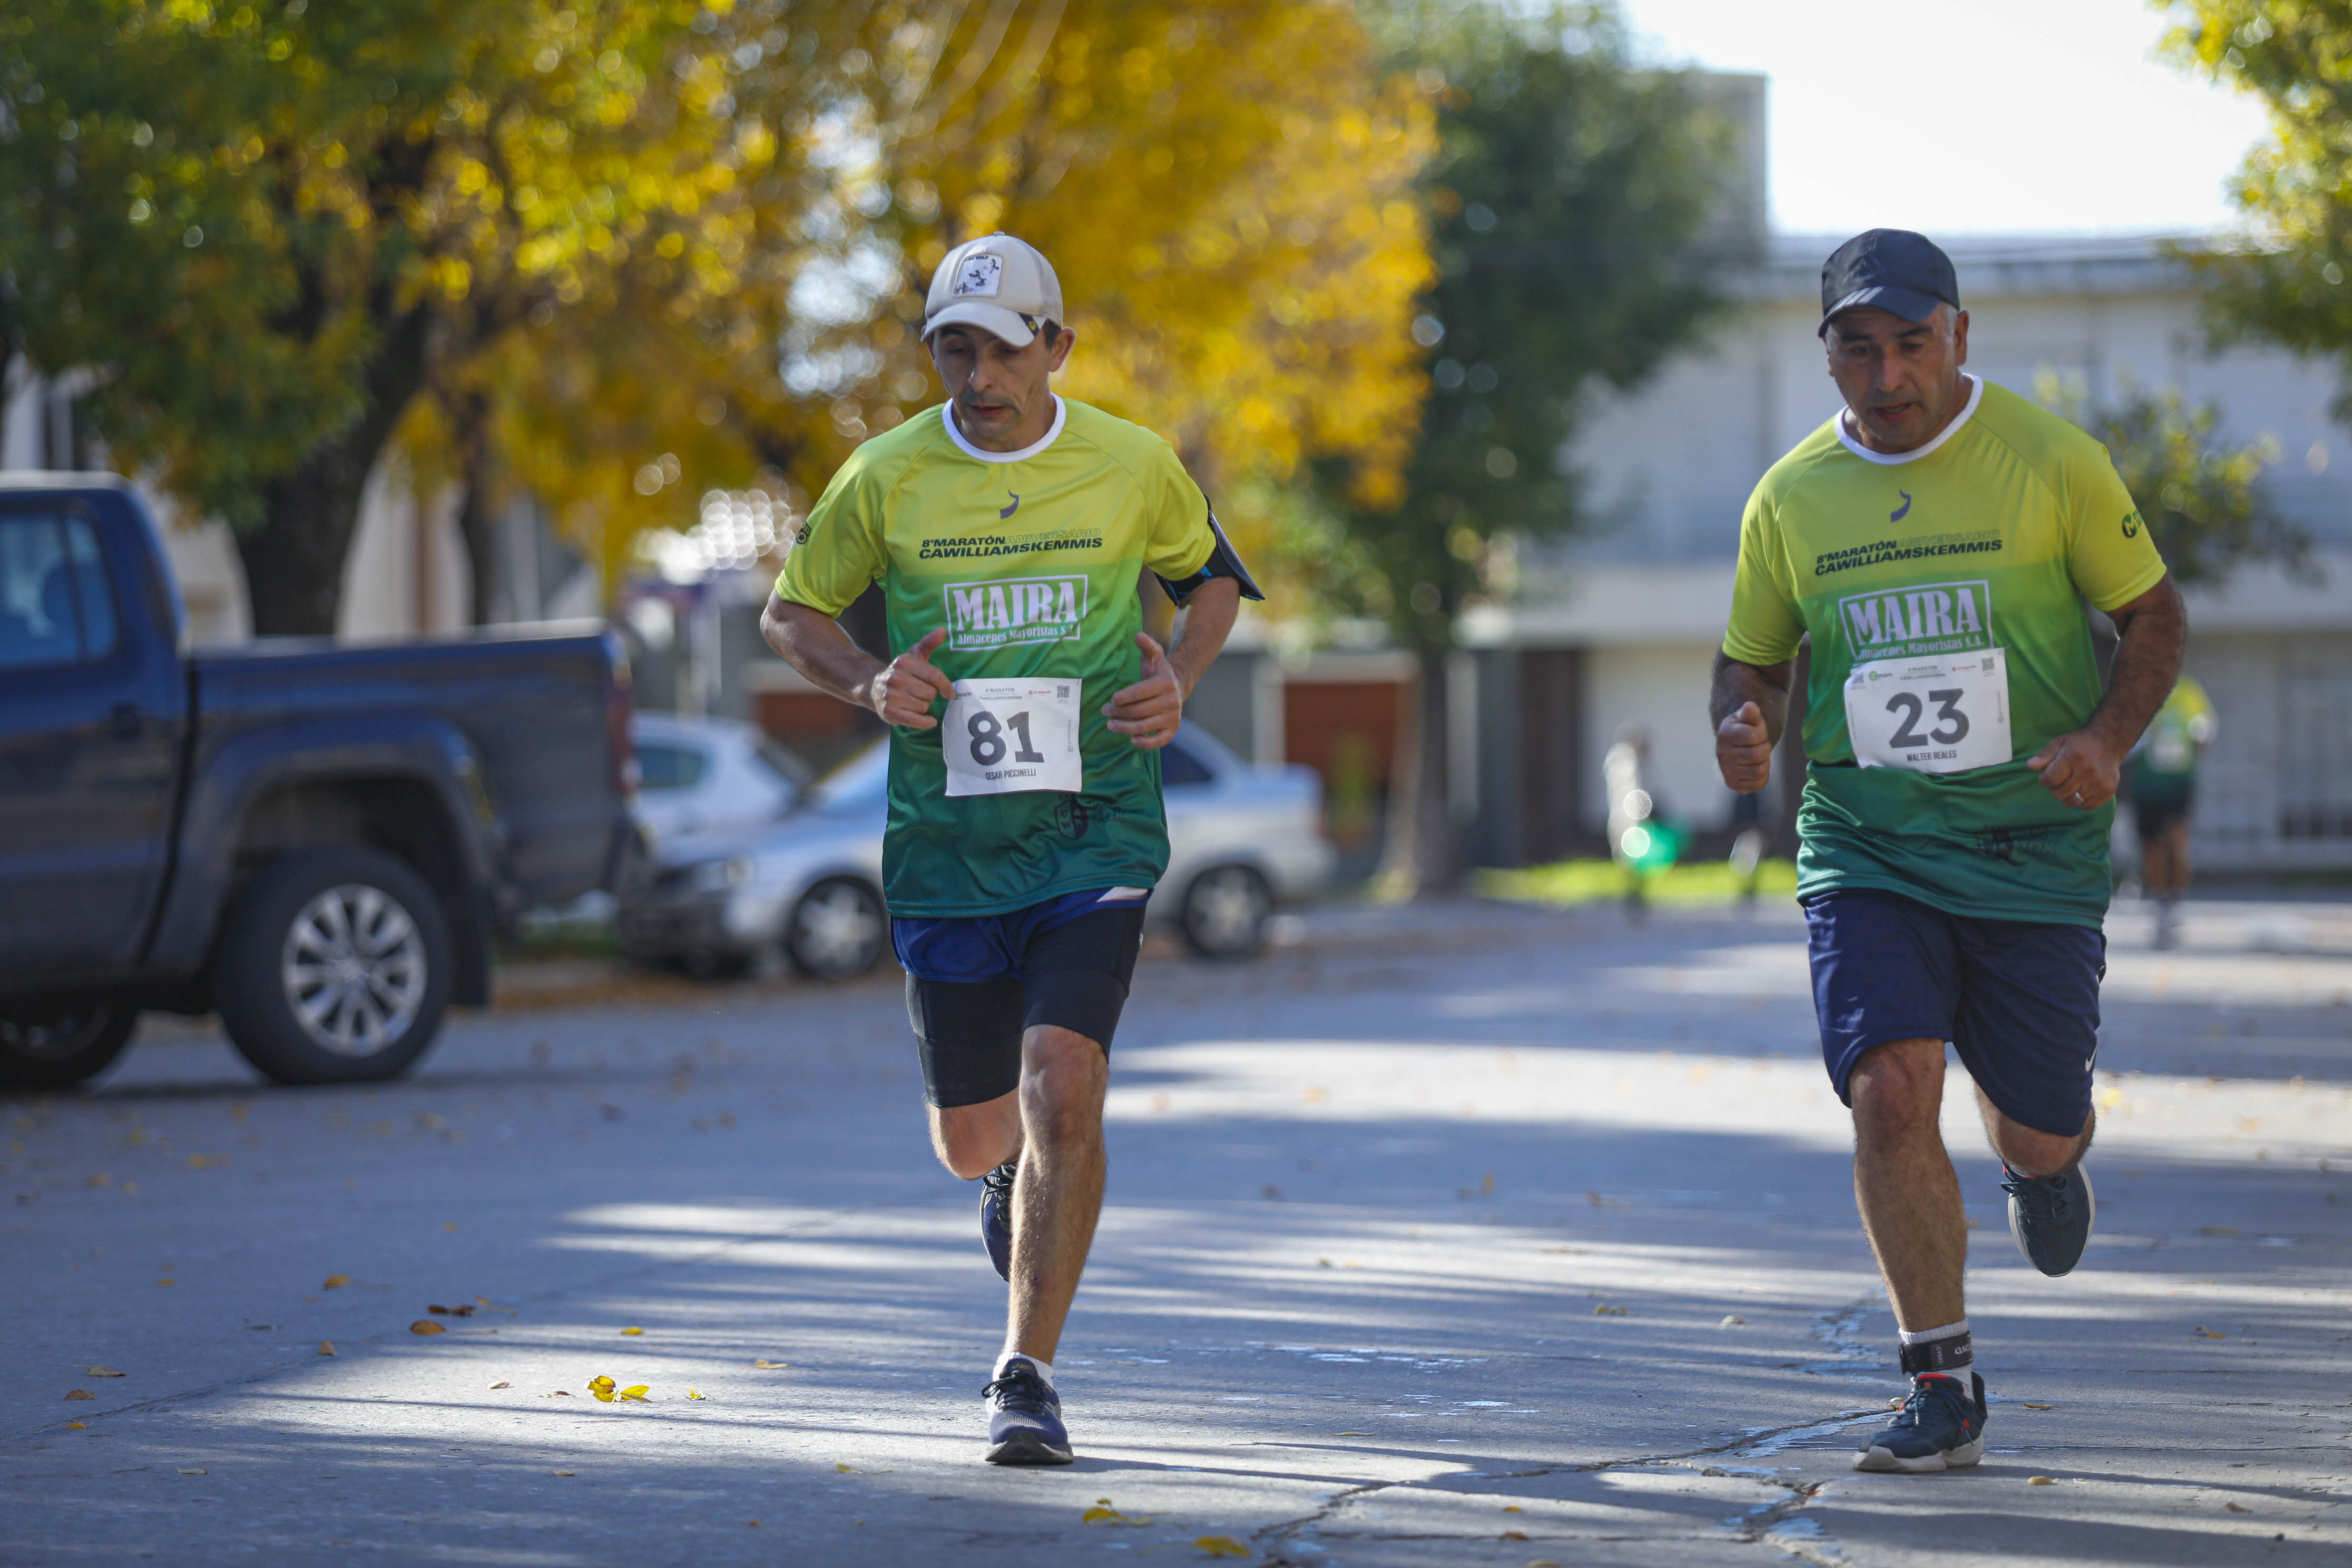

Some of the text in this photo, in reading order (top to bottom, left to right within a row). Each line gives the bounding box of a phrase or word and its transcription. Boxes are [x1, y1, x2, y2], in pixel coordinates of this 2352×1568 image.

[919, 537, 1102, 558] CAWILLIAMSKEMMIS
[1815, 540, 2003, 576] CAWILLIAMSKEMMIS
[952, 582, 1077, 631] MAIRA
[1847, 588, 1983, 646] MAIRA
[957, 632, 1007, 645] Almacenes
[1009, 625, 1058, 640] Mayoristas
[1908, 638, 1963, 654] Mayoristas
[1886, 688, 1970, 749] 23
[967, 711, 1045, 766] 81
[1906, 752, 1932, 762] WALTER
[985, 768, 1037, 780] CESAR PICCINELLI
